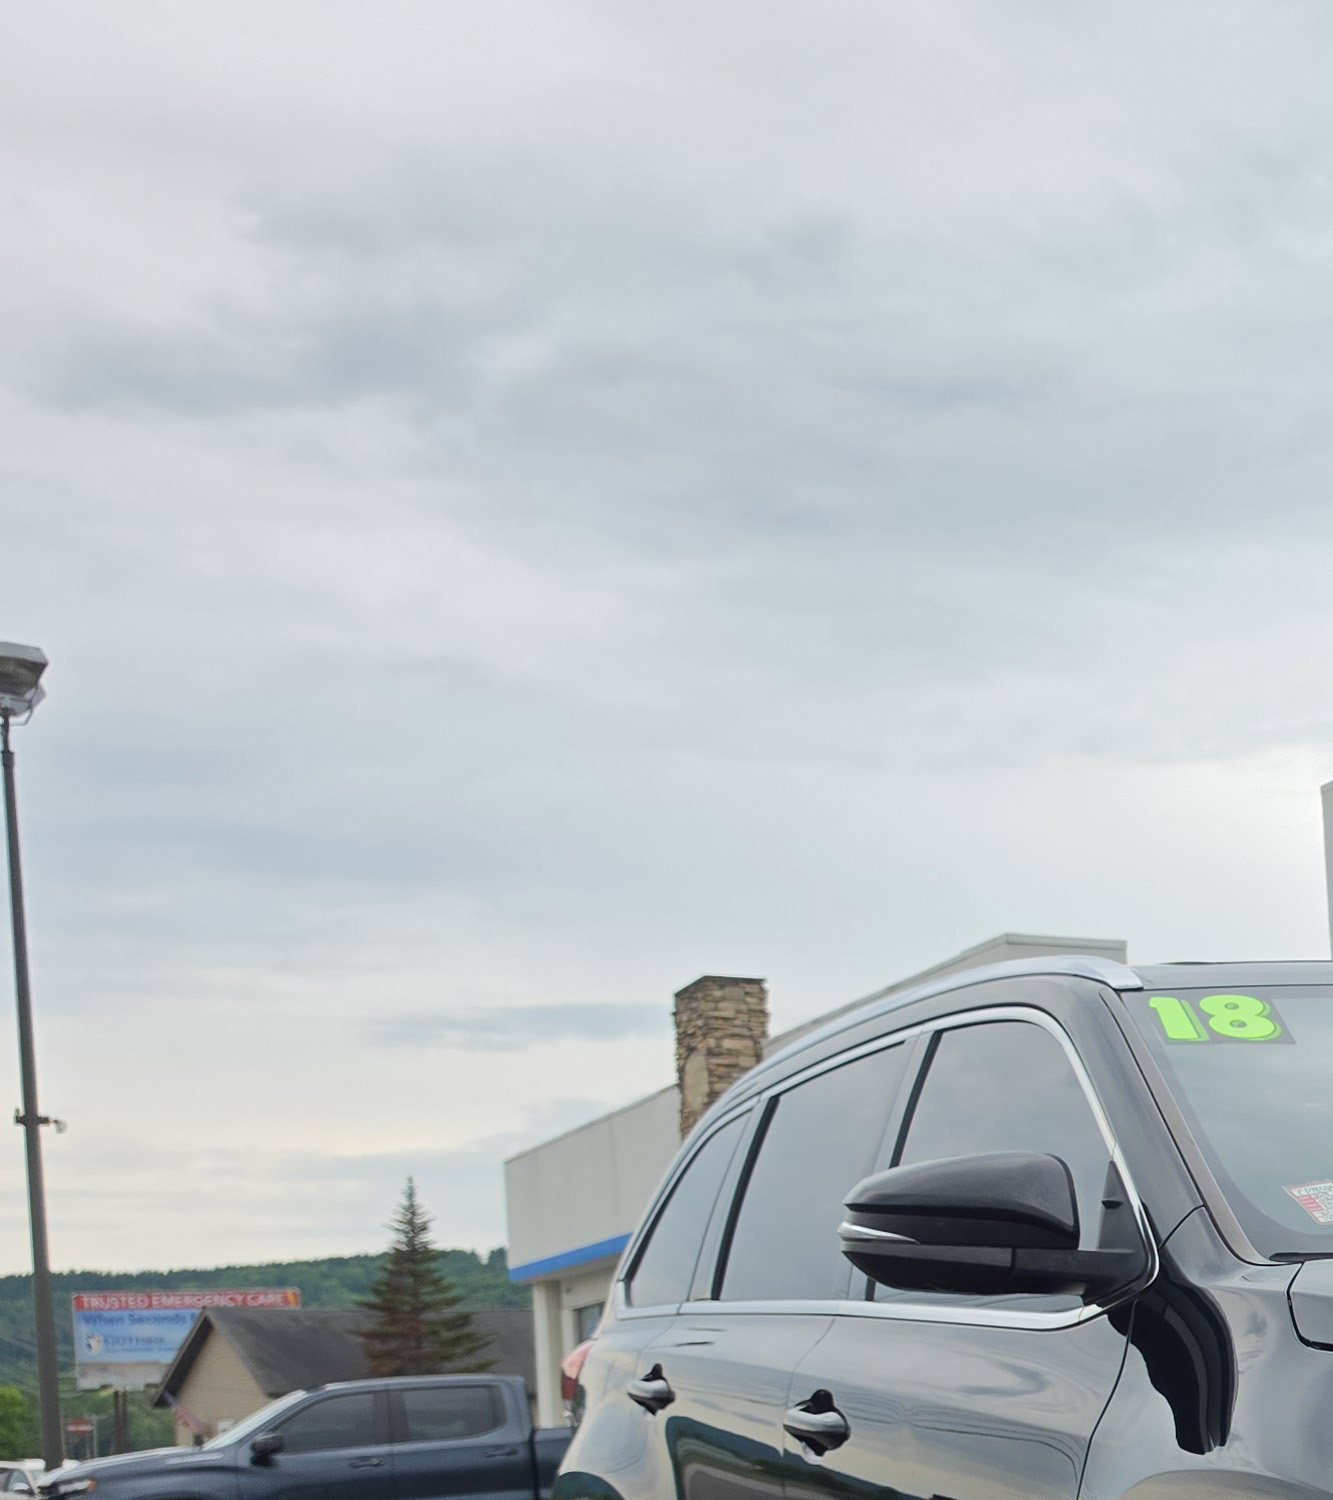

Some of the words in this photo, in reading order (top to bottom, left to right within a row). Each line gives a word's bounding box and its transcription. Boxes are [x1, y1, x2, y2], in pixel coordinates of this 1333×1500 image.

[1148, 994, 1281, 1041] 18
[82, 1295, 149, 1310] TRUSTED
[152, 1291, 243, 1308] EMERGENCY
[246, 1291, 286, 1307] CARE
